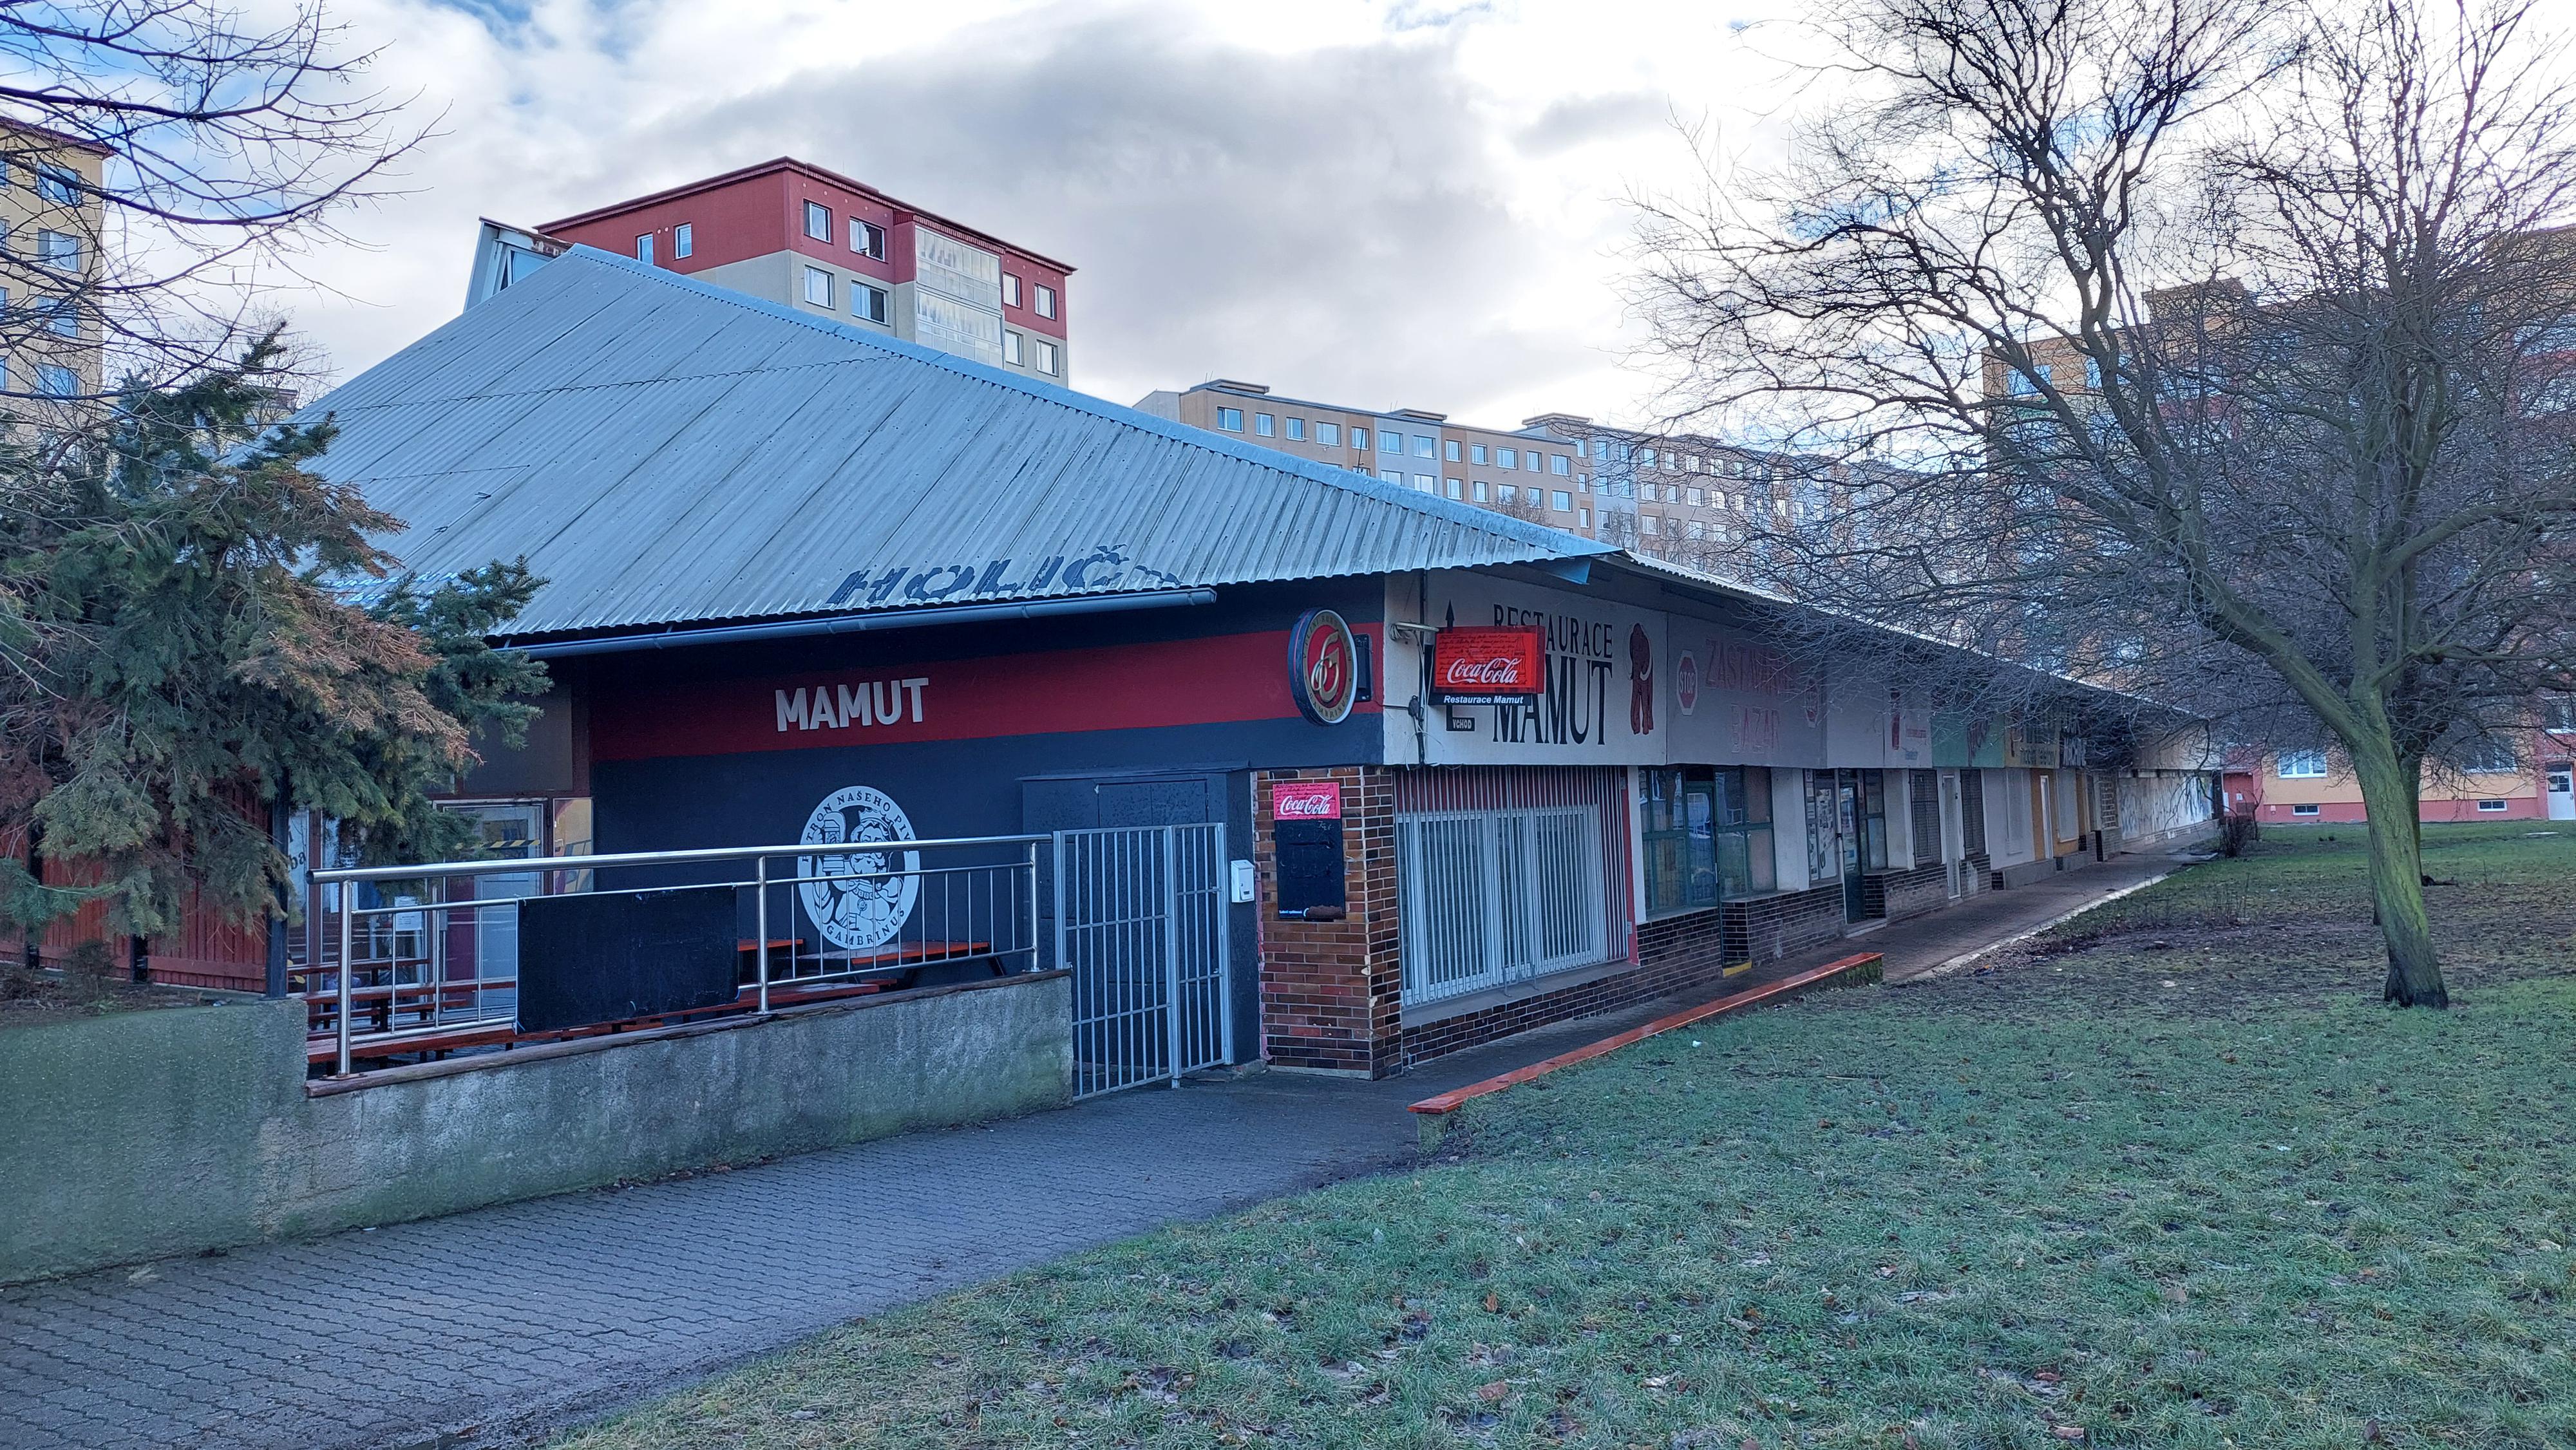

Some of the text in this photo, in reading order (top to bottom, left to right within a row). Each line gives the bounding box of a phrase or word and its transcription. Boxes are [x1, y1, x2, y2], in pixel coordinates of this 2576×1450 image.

[1446, 657, 1522, 684] Coca-Cola
[1679, 671, 1695, 694] STOP
[775, 677, 929, 732] MAMUT
[1443, 695, 1524, 705] Restaurace Mamut
[837, 790, 891, 812] NAŠEHO
[1280, 794, 1333, 816] Coca-Cola
[826, 909, 905, 946] GAMBRINUS
